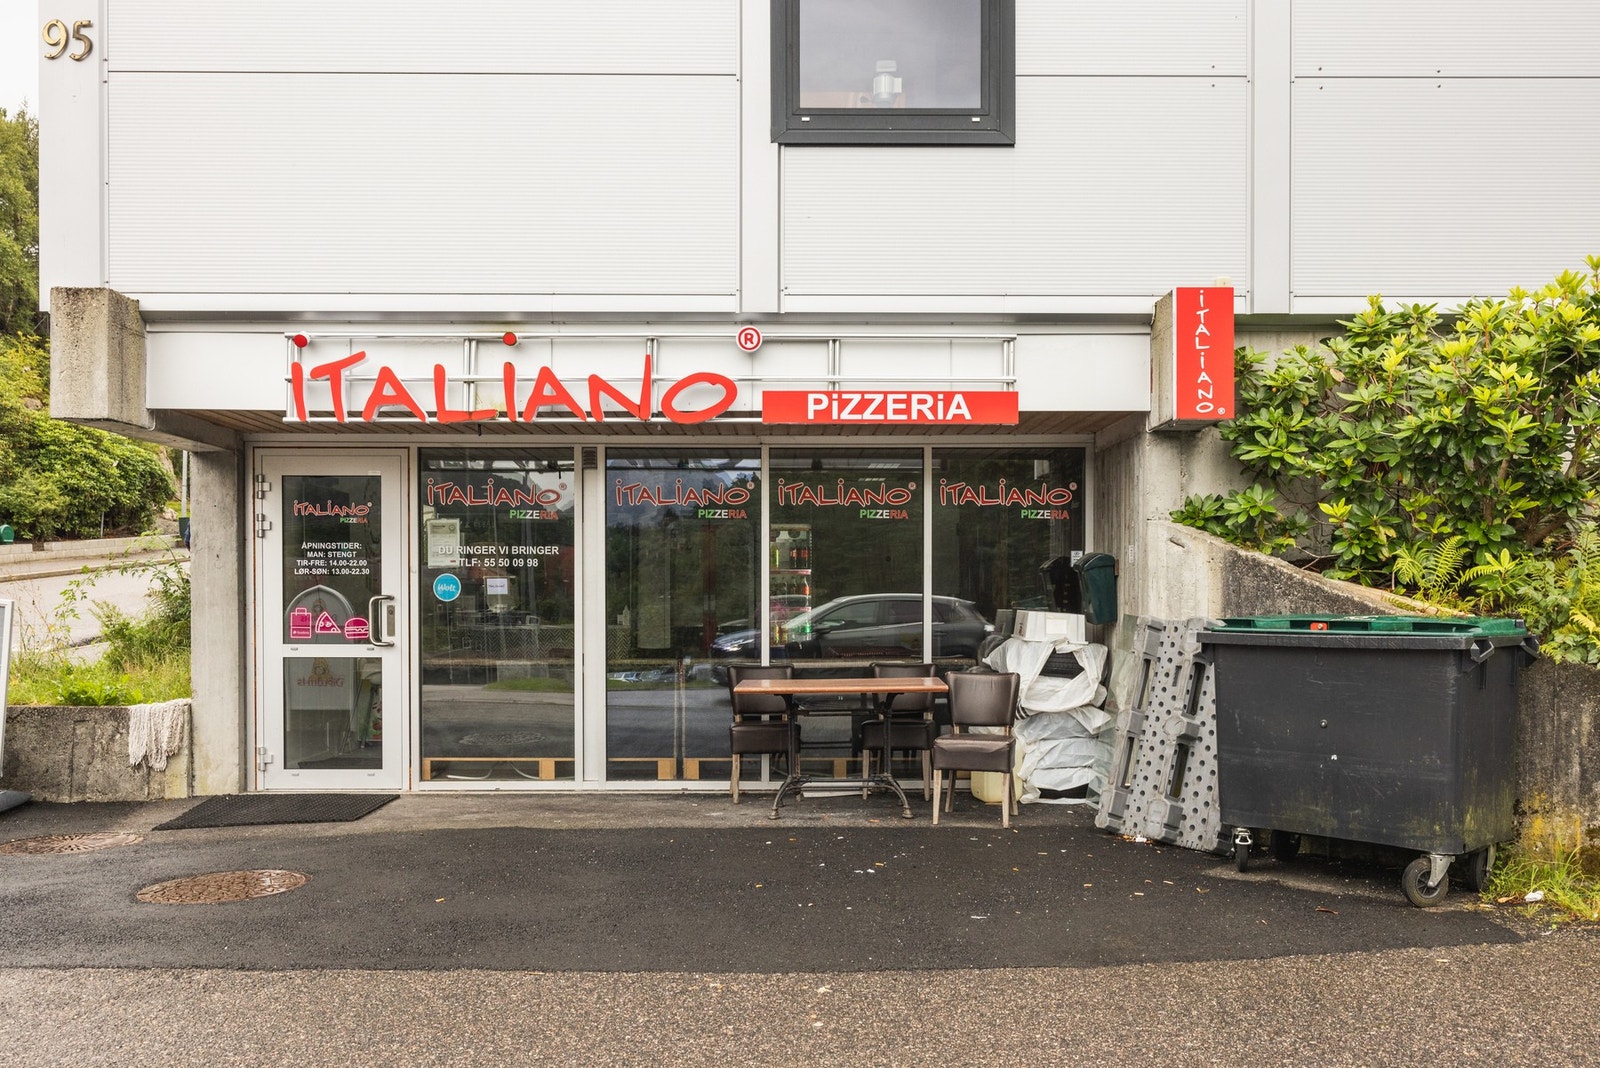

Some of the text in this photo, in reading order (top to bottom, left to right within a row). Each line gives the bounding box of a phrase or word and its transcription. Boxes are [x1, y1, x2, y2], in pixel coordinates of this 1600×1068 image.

[42, 18, 93, 62] 95
[807, 393, 972, 421] PiZZERiA
[509, 509, 559, 519] PIZZERIA
[698, 509, 748, 519] PIZZERIA
[859, 509, 909, 519] PIZZERIA
[1020, 509, 1070, 519] PIZZERIA
[301, 541, 362, 549] ÅPNINGSTIDER:
[438, 546, 560, 555] DU RINGER VI BRINGER
[459, 558, 539, 567] TLF: 55 50 09 98
